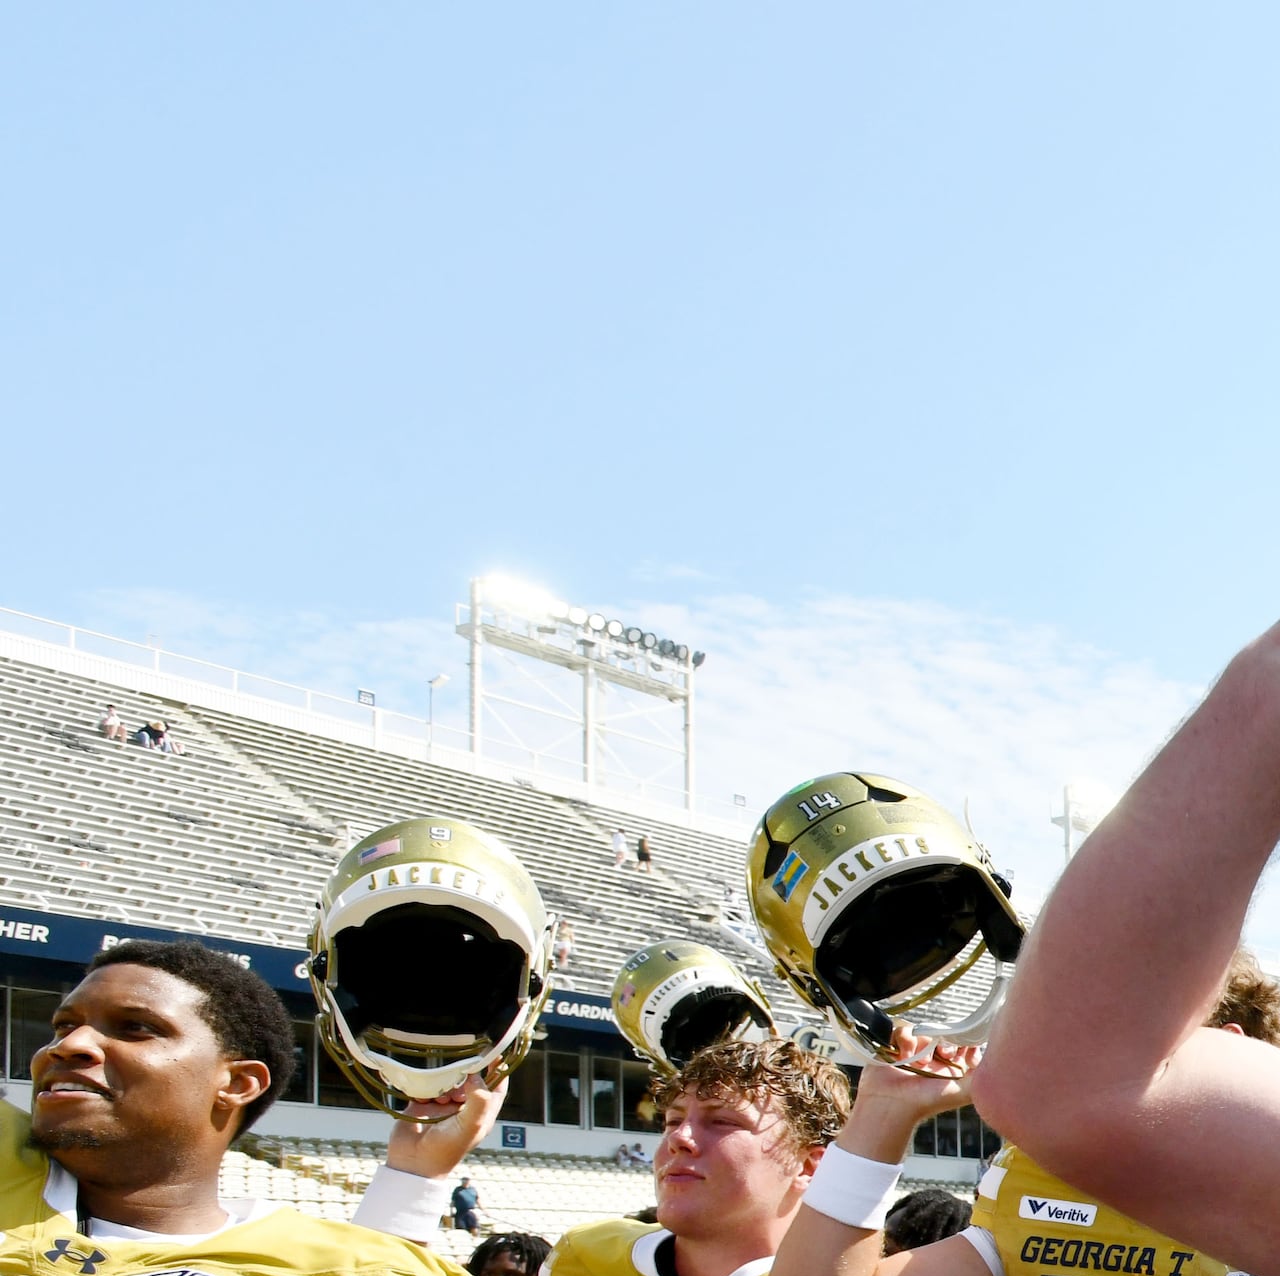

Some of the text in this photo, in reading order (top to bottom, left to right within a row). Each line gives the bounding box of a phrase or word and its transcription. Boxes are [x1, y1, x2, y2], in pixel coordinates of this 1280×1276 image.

[798, 792, 841, 822] 14
[429, 826, 451, 841] 9
[368, 865, 507, 904] JACKETS
[812, 836, 930, 912] JACKETS
[557, 1001, 616, 1022] GARDN
[507, 1133, 521, 1144] C2
[1020, 1235, 1157, 1276] GEORGIA
